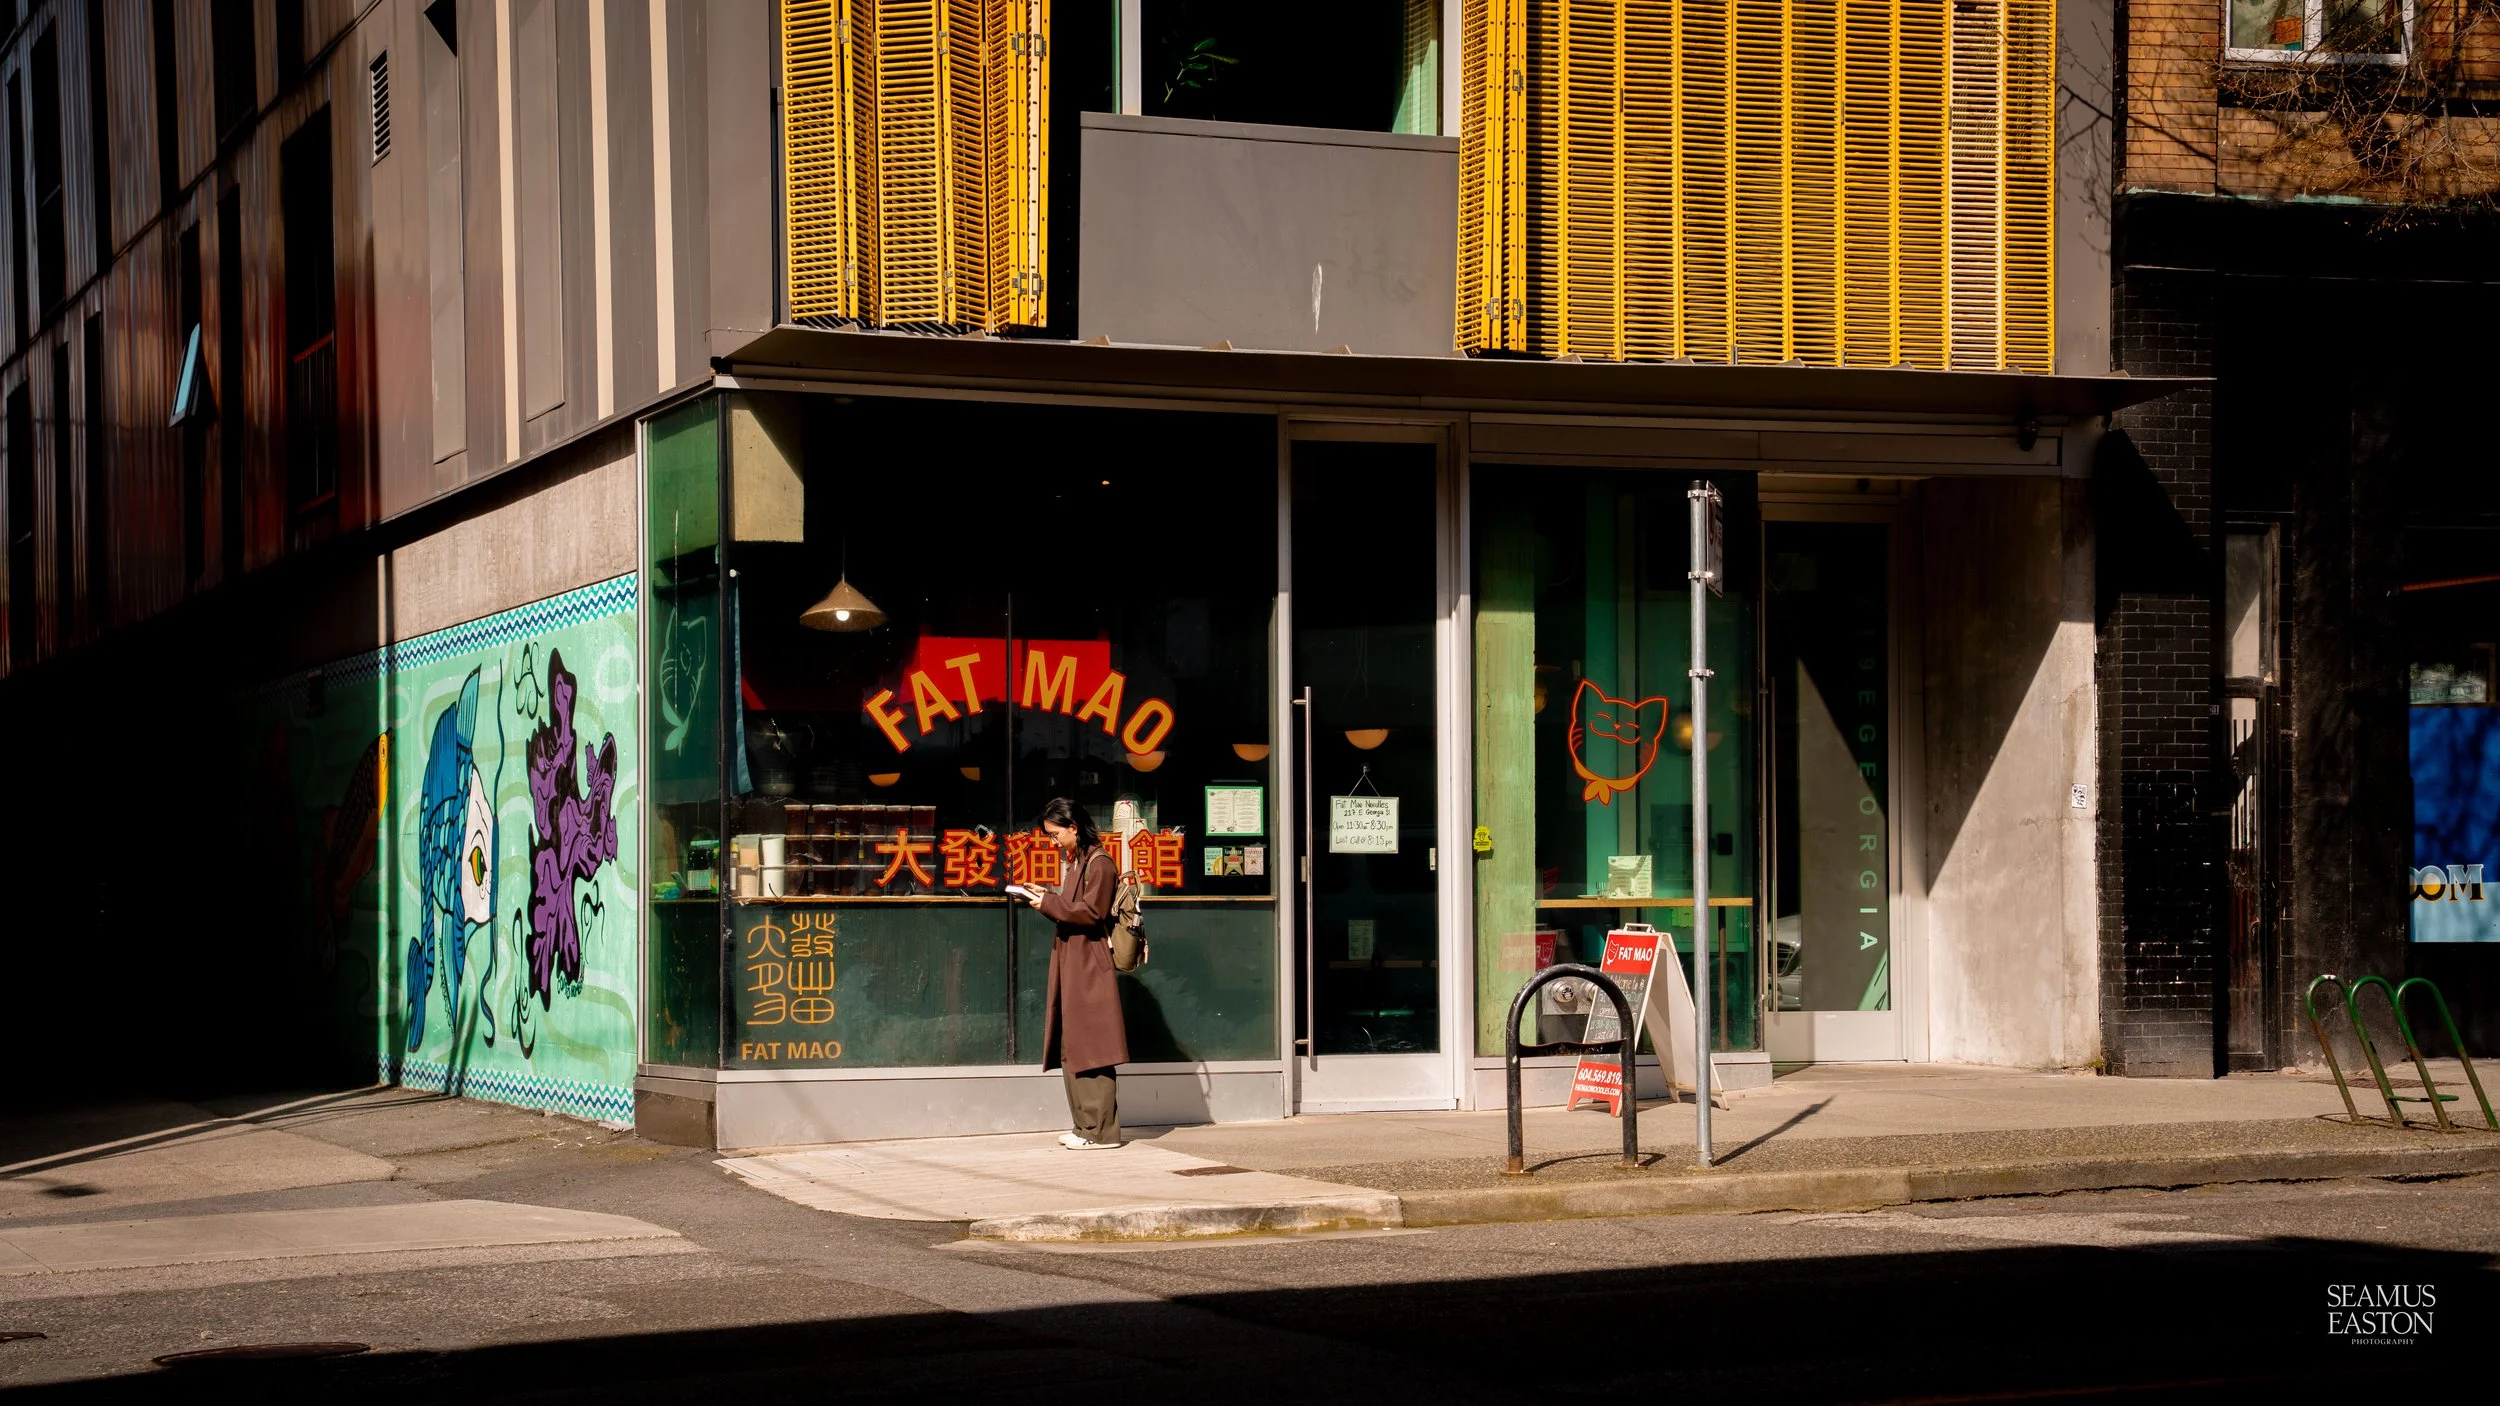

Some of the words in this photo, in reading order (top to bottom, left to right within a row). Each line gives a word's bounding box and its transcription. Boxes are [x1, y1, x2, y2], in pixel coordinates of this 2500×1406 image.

[863, 652, 981, 753] FAT
[1020, 649, 1175, 756] MAO
[1335, 800, 1347, 809] Fat
[1350, 800, 1362, 808] Mao
[1365, 800, 1389, 809] Noodles
[1365, 809, 1384, 817] Georgia
[1858, 724, 1879, 951] GEORGIA
[873, 827, 1186, 888] 大發貓館
[1618, 946, 1633, 960] FAT
[1633, 947, 1653, 961] MAO
[741, 1041, 781, 1061] FAT
[787, 1040, 842, 1060] MAO
[1574, 1083, 1621, 1097] FATMAONOODLES.COM
